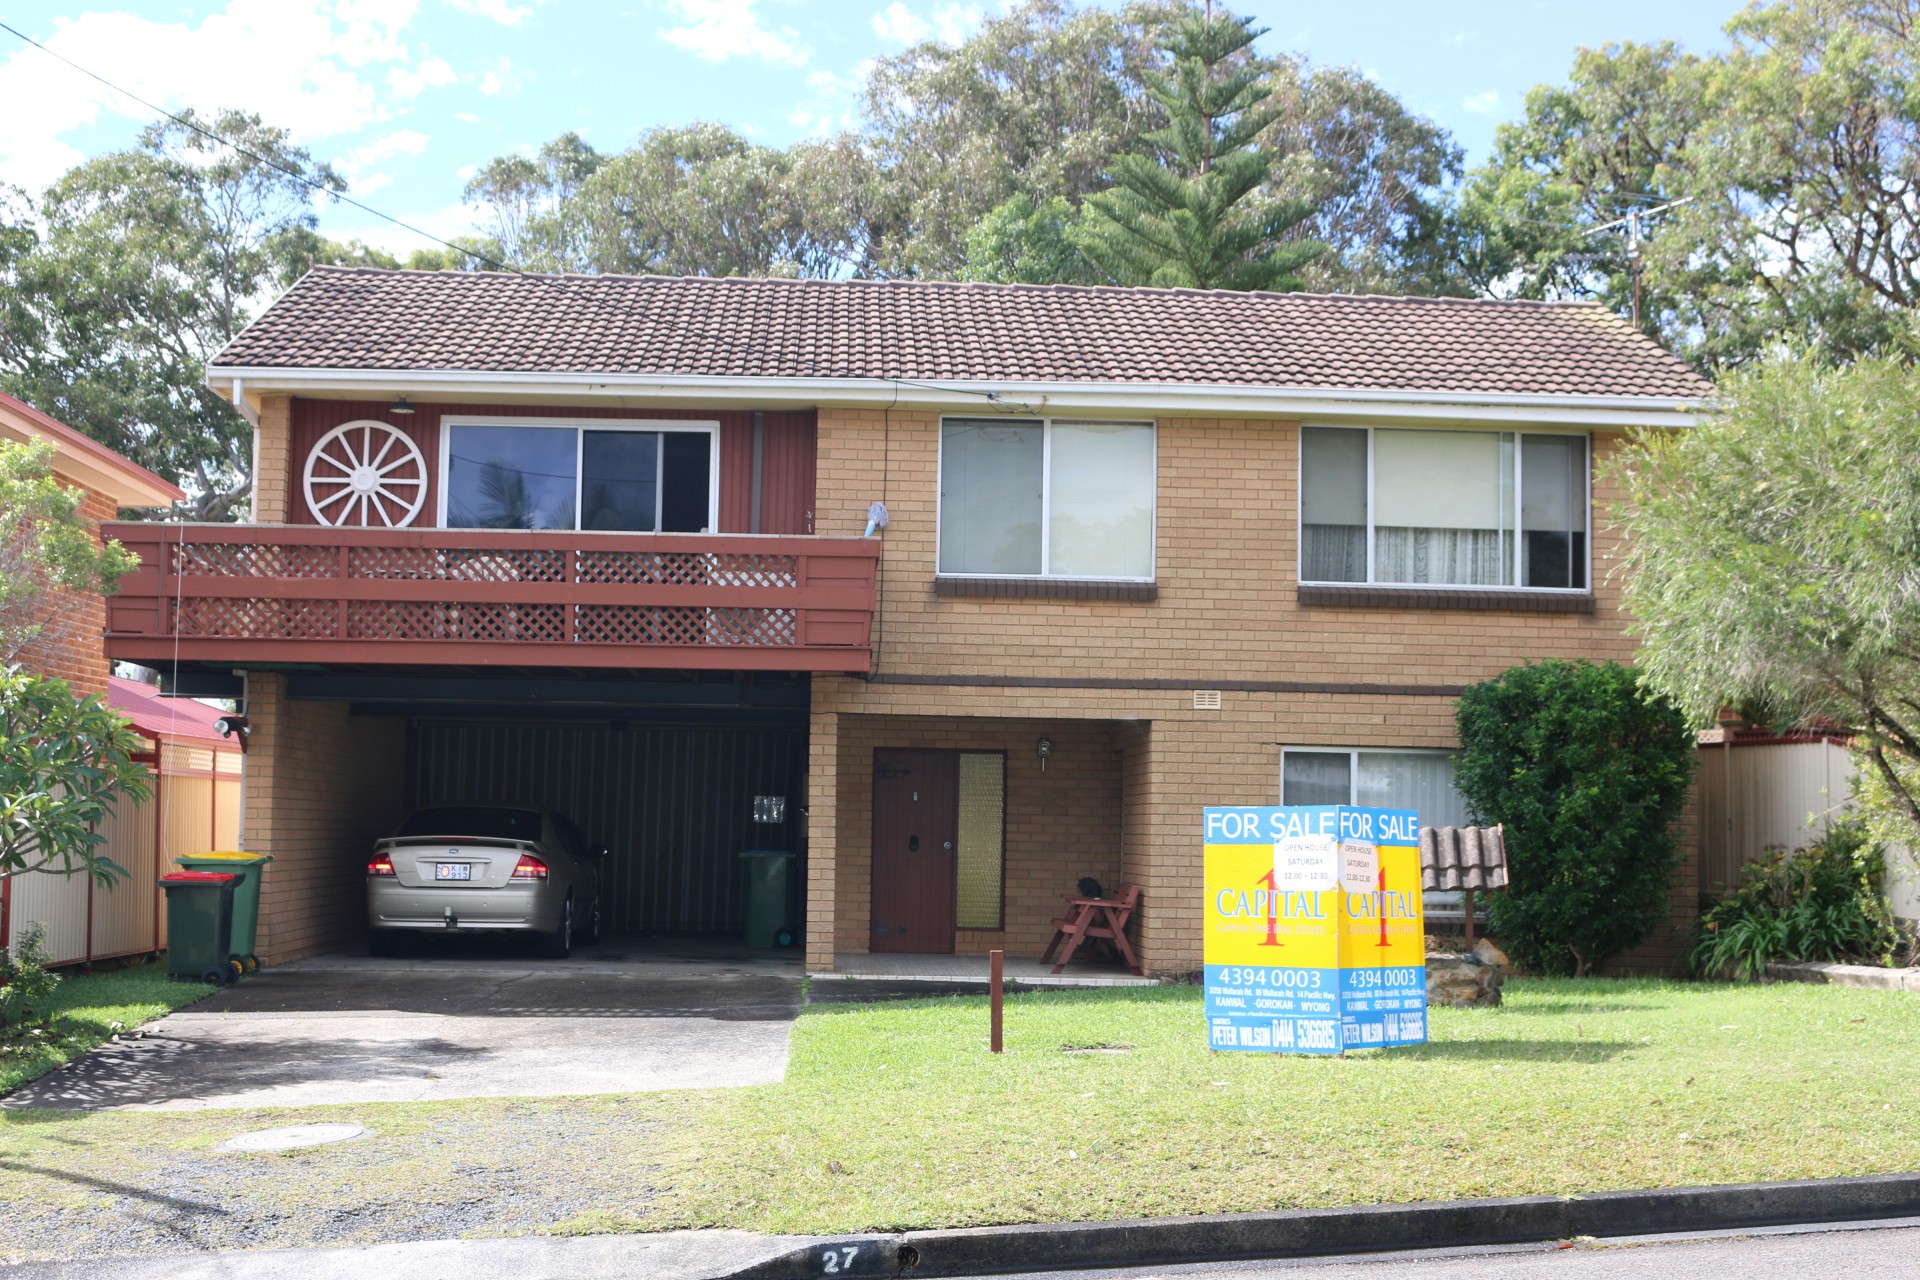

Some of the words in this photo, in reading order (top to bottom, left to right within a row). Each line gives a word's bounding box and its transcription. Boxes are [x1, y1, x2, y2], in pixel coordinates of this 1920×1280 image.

[1206, 812, 1261, 838] FOR
[1270, 812, 1335, 839] SALE
[1340, 812, 1374, 839] FOR
[1378, 814, 1418, 841] SALE
[1284, 844, 1303, 852] OPEN
[1304, 844, 1328, 852] HOUSE
[1344, 844, 1357, 853] OPEN
[1358, 846, 1372, 855] HOUSE
[1288, 858, 1324, 866] SATURDAY
[1346, 859, 1370, 868] SATURDAY
[1284, 872, 1302, 880] 12.00
[1310, 872, 1328, 880] 12.30
[1216, 888, 1327, 919] CAPITAL
[1346, 890, 1418, 919] CAPITAL
[1219, 968, 1266, 986] 4394
[1270, 970, 1321, 988] 0003
[1349, 970, 1382, 988] 4394
[1384, 969, 1416, 986] 0003
[1216, 997, 1247, 1008] KANWAL
[1301, 1002, 1330, 1012] WYONG
[1346, 1000, 1369, 1011] KANWAL
[1404, 998, 1422, 1008] WYONG
[1212, 1026, 1238, 1046] PETER
[1240, 1026, 1271, 1047] WILSON
[1272, 1019, 1294, 1048] 0414
[1297, 1020, 1336, 1048] 536685
[1342, 1024, 1360, 1044] PETER
[1361, 1022, 1384, 1043] WILSON
[822, 1246, 859, 1274] 27
